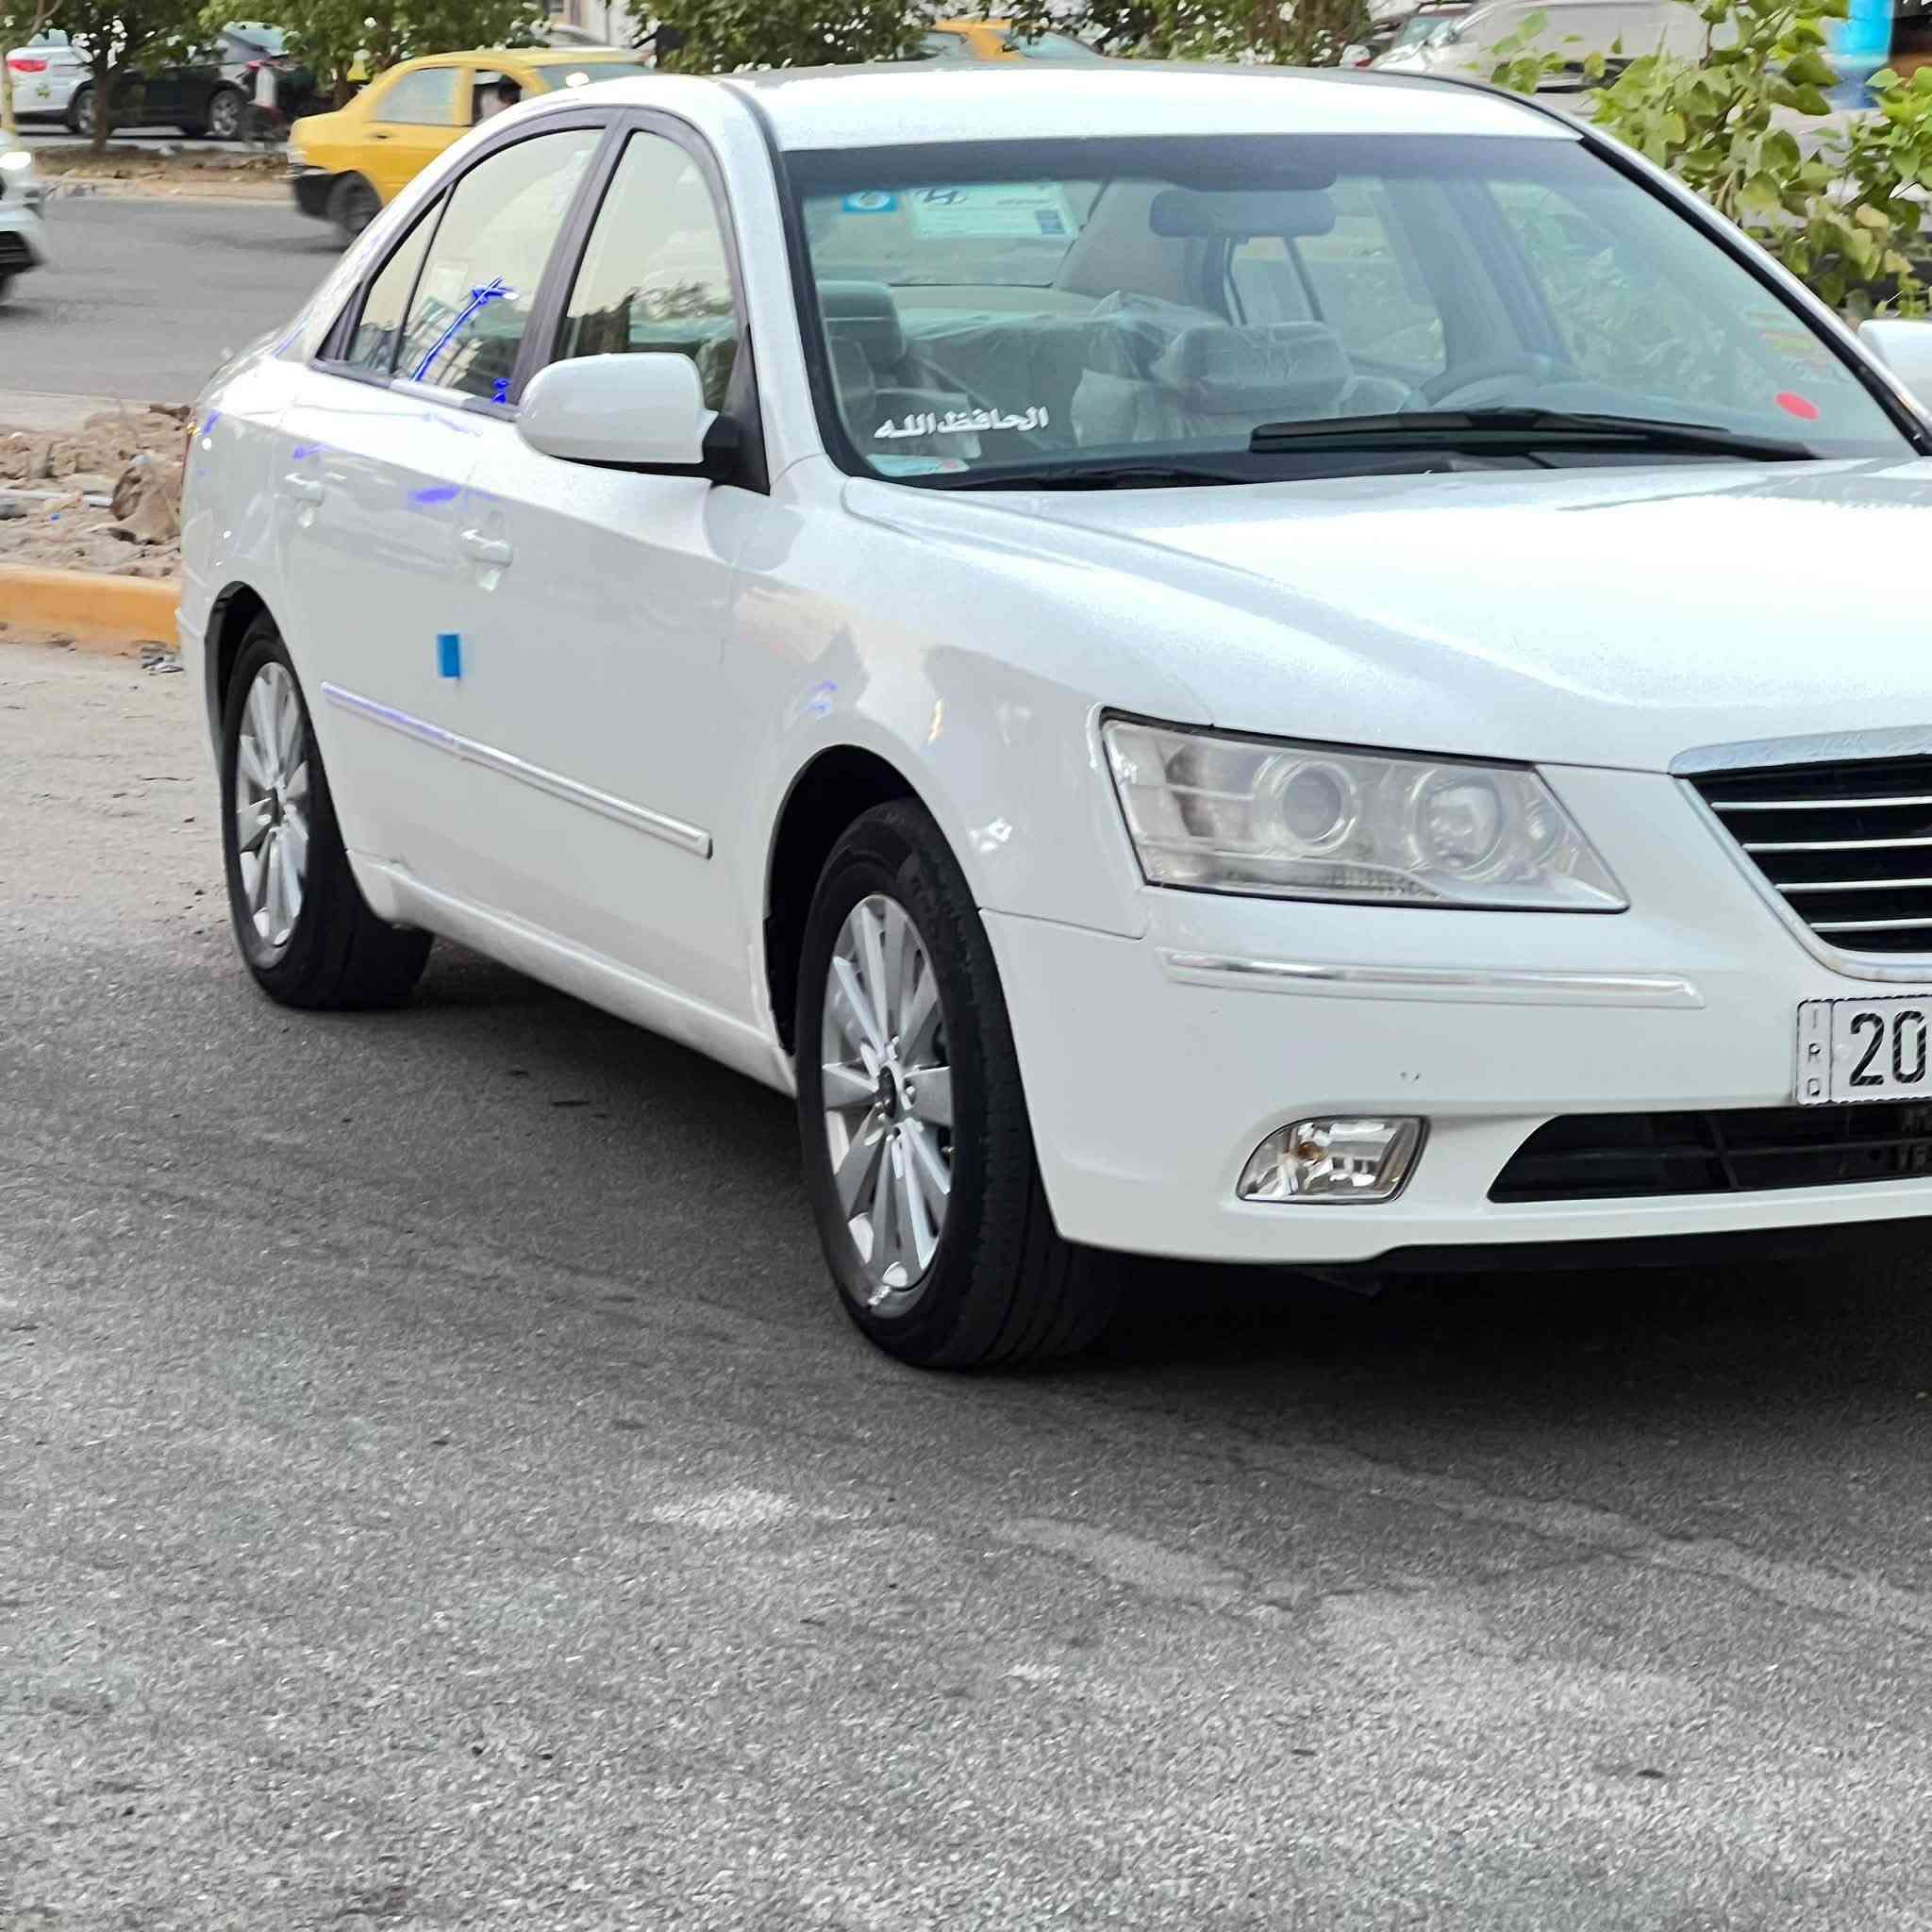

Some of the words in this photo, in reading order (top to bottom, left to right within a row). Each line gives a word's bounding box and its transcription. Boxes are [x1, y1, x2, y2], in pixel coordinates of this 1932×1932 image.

[874, 412, 936, 439] الله
[938, 407, 1049, 433] الحافظ
[1849, 1010, 1926, 1087] 20
